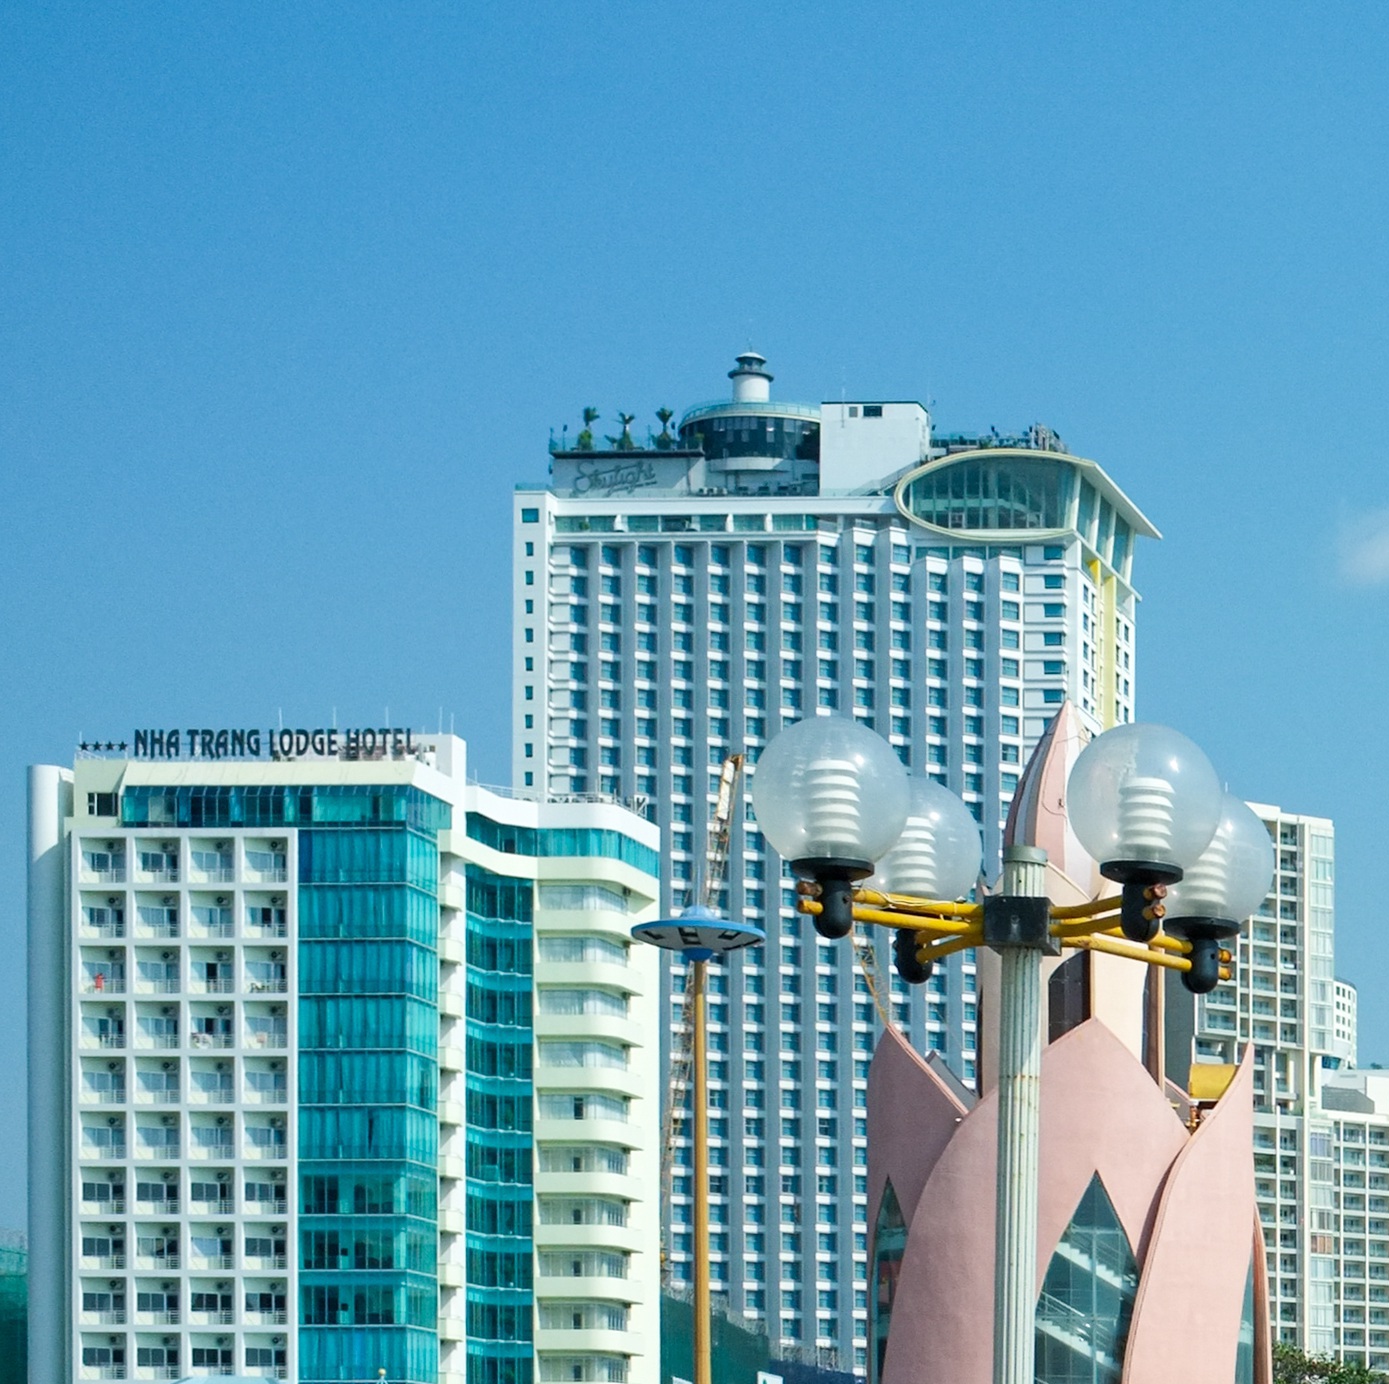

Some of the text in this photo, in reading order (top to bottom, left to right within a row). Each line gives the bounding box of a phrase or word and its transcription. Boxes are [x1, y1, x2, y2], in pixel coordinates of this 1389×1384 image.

[134, 728, 418, 759] NHA TRANG LODGE HOTEL
